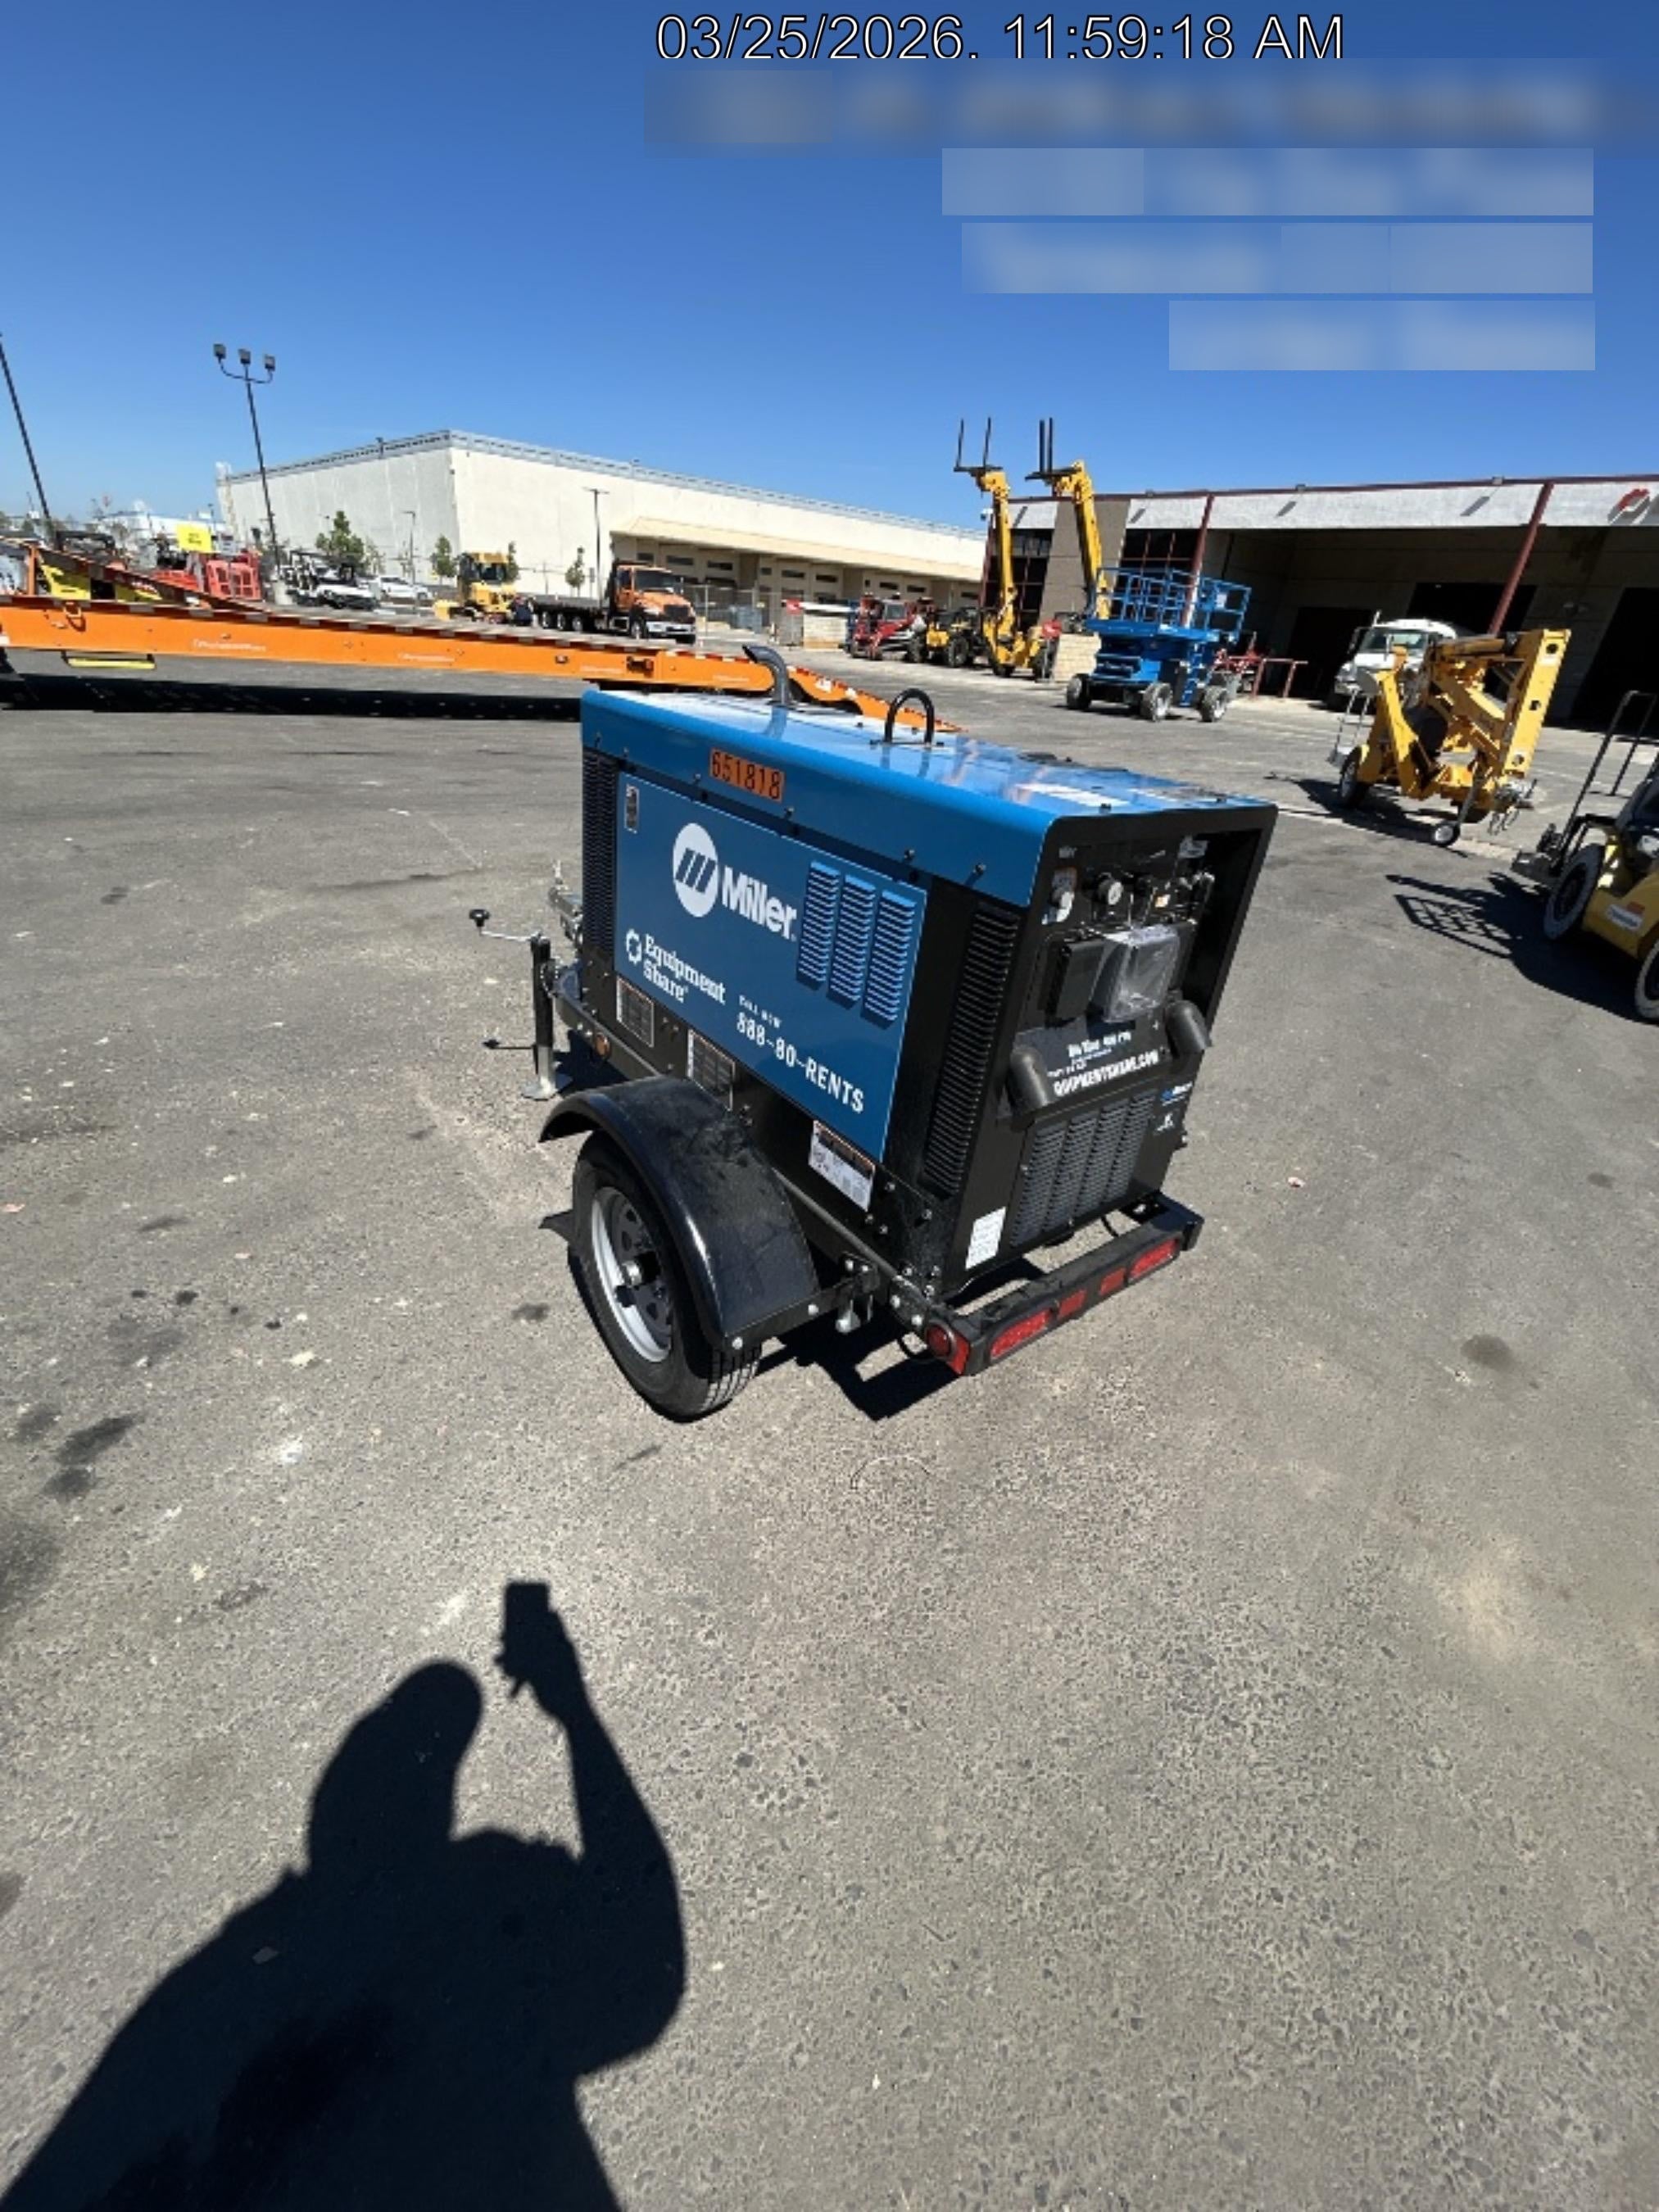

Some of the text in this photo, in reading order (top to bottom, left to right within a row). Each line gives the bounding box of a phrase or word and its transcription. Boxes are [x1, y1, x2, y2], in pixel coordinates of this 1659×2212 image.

[711, 750, 781, 800] 651818
[721, 864, 797, 941] Miller
[643, 958, 686, 1004] Share
[645, 933, 726, 1005] Equipment
[737, 1012, 864, 1113] 888-80-RENTS
